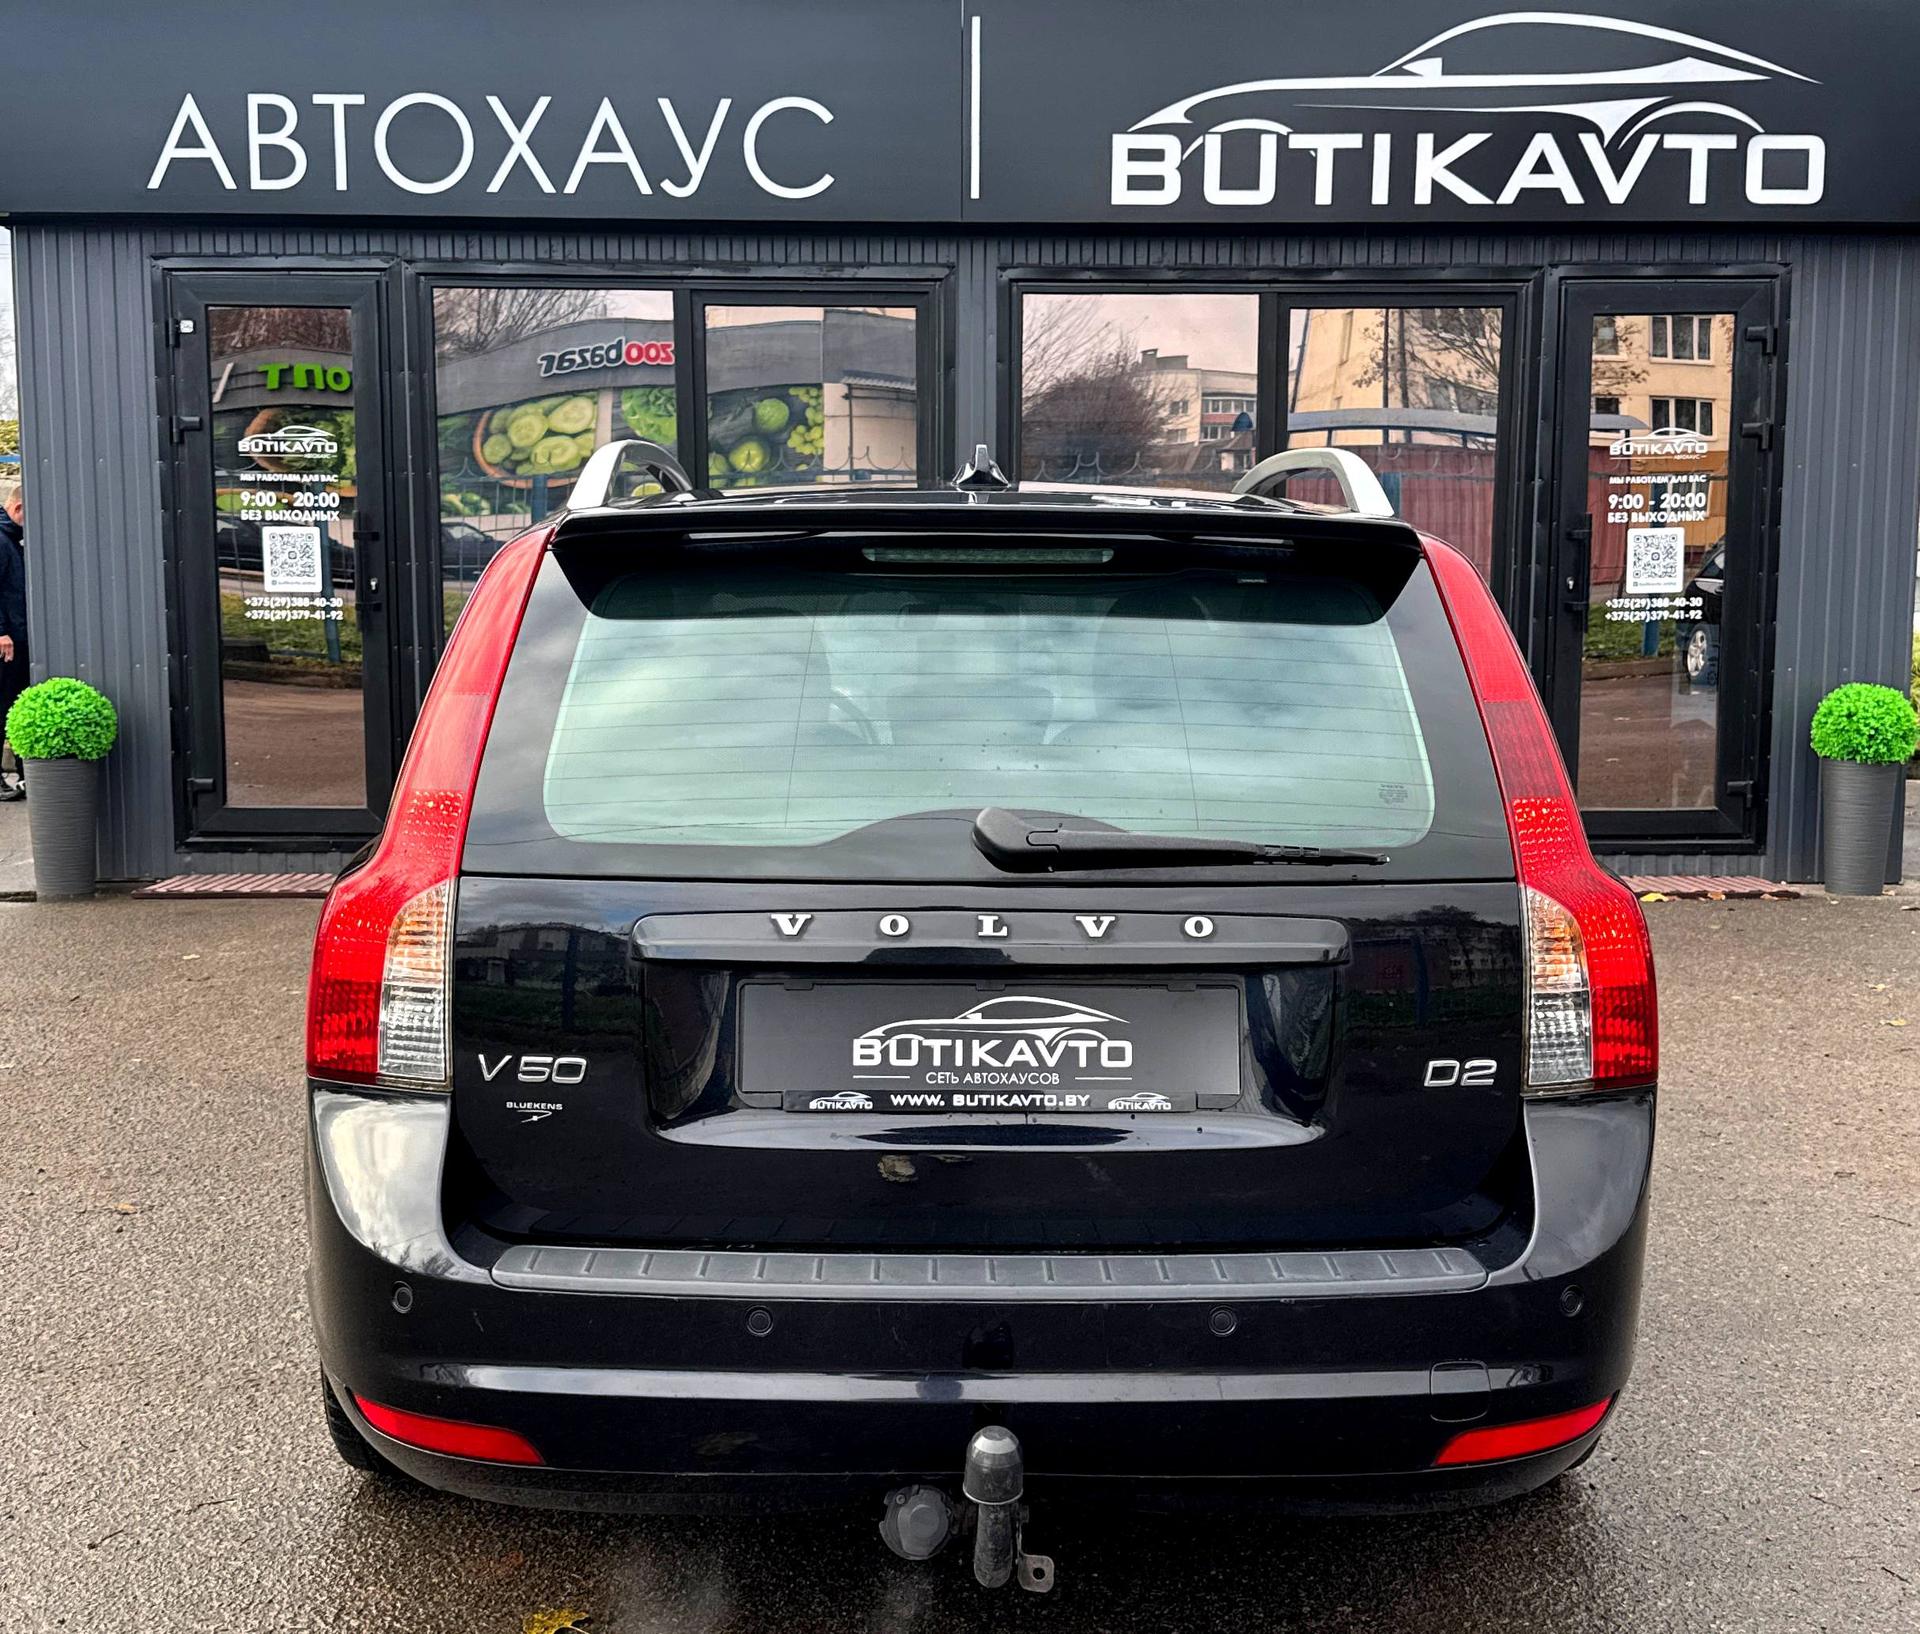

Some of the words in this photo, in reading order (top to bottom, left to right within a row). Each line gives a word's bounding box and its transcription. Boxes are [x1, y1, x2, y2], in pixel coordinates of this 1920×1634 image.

[147, 93, 835, 199] АВТОХАУС
[1110, 132, 1826, 206] BUTIKAVTO
[238, 441, 338, 453] BUTIKAVTO
[1609, 442, 1708, 455] BUTIKAVTO
[240, 474, 255, 482] МЫ
[257, 474, 300, 482] РАБОТАЕМ
[301, 475, 319, 483] ДЛЯ
[321, 475, 339, 483] ВАС
[1609, 476, 1625, 484] МЫ
[1626, 476, 1668, 484] РАБОТАЕМ
[1668, 475, 1687, 483] ДЛЯ
[240, 491, 277, 507] 9:00
[293, 491, 340, 508] 20:00
[1608, 493, 1644, 509] 9:00
[1660, 492, 1707, 508] 20:00
[240, 510, 263, 521] БЕЗ
[265, 510, 340, 522] ВЫХОДНЫХ
[1607, 512, 1629, 523] БЕЗ
[1631, 511, 1705, 522] ВЫХОДНЫХ
[244, 609, 344, 622] +375(29)379-41-92
[1605, 610, 1703, 623] +375(29)379-41-92
[770, 913, 1215, 938] VOLVO
[852, 1037, 1133, 1067] BUTIKAVTO
[925, 1072, 960, 1084] СЕТЬ
[963, 1072, 1060, 1085] АВТОХАУСОВ
[1423, 1059, 1498, 1087] D2
[506, 1101, 563, 1110] BLUEKENS
[809, 1099, 873, 1110] BUTIKAVTO
[953, 1094, 1090, 1107] BUTIKAVTO.BY
[1108, 1100, 1172, 1110] BUTIKAVTO
